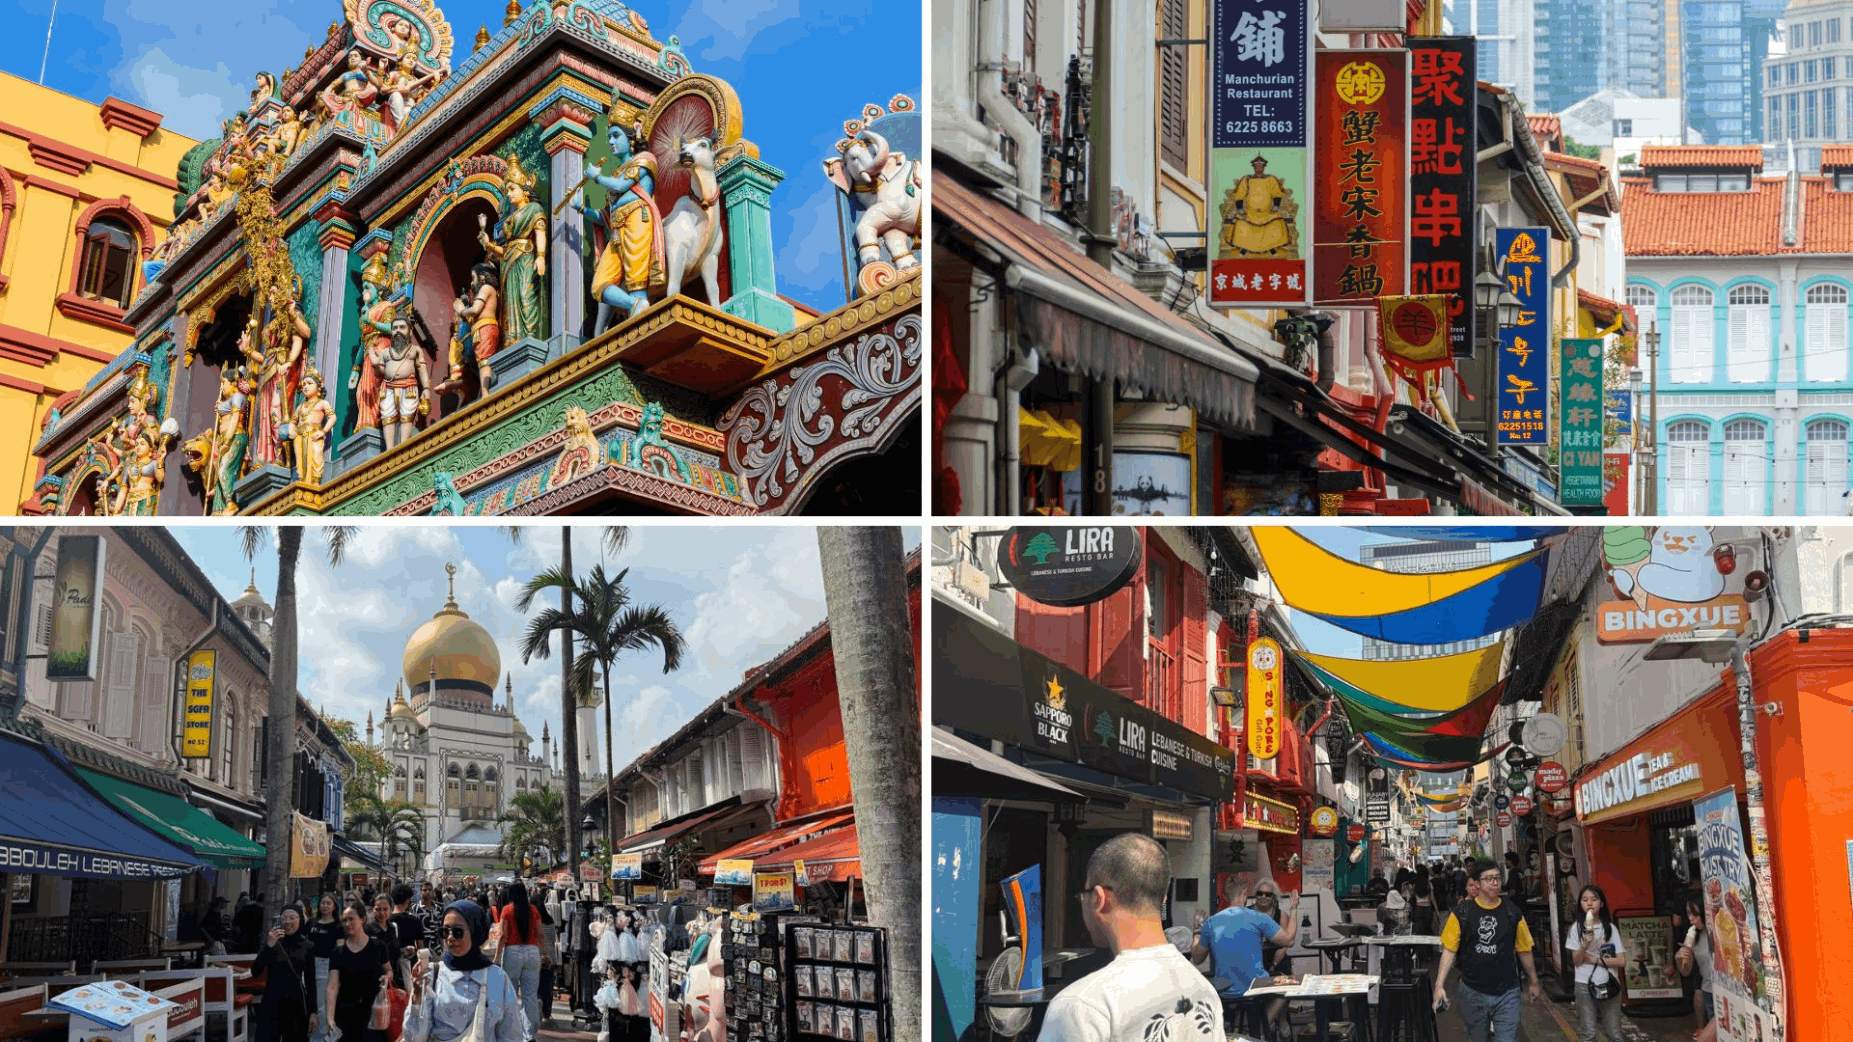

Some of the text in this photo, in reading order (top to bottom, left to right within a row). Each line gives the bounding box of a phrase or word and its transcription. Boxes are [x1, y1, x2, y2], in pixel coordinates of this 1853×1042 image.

[1225, 73, 1295, 84] Manchurian
[1227, 88, 1293, 99] Restaurant
[1243, 104, 1275, 117] TEL:
[1226, 121, 1293, 133] 6225 8663
[1498, 421, 1544, 431] 62251518
[1065, 527, 1114, 555] LIRA
[1065, 552, 1114, 562] RESTO BAR
[1604, 605, 1741, 632] BINGXUE
[191, 688, 208, 697] THE
[1034, 702, 1073, 727] SAPPORO
[186, 721, 209, 729] STORE
[1038, 721, 1068, 744] BLACK
[1119, 717, 1146, 752] LIRA
[1151, 730, 1213, 768] LEBANESE & TURKISH
[1151, 748, 1177, 771] CUISINE
[1582, 752, 1651, 815] BINGXUE
[1649, 756, 1662, 773] TEA
[1651, 763, 1698, 792] ICE CREAM
[1698, 823, 1740, 859] BINGXUE
[82, 856, 151, 878] LEBANESE
[813, 865, 833, 875] SHOP
[1620, 921, 1669, 930] MATCHA
[1628, 930, 1665, 938] LATTE
